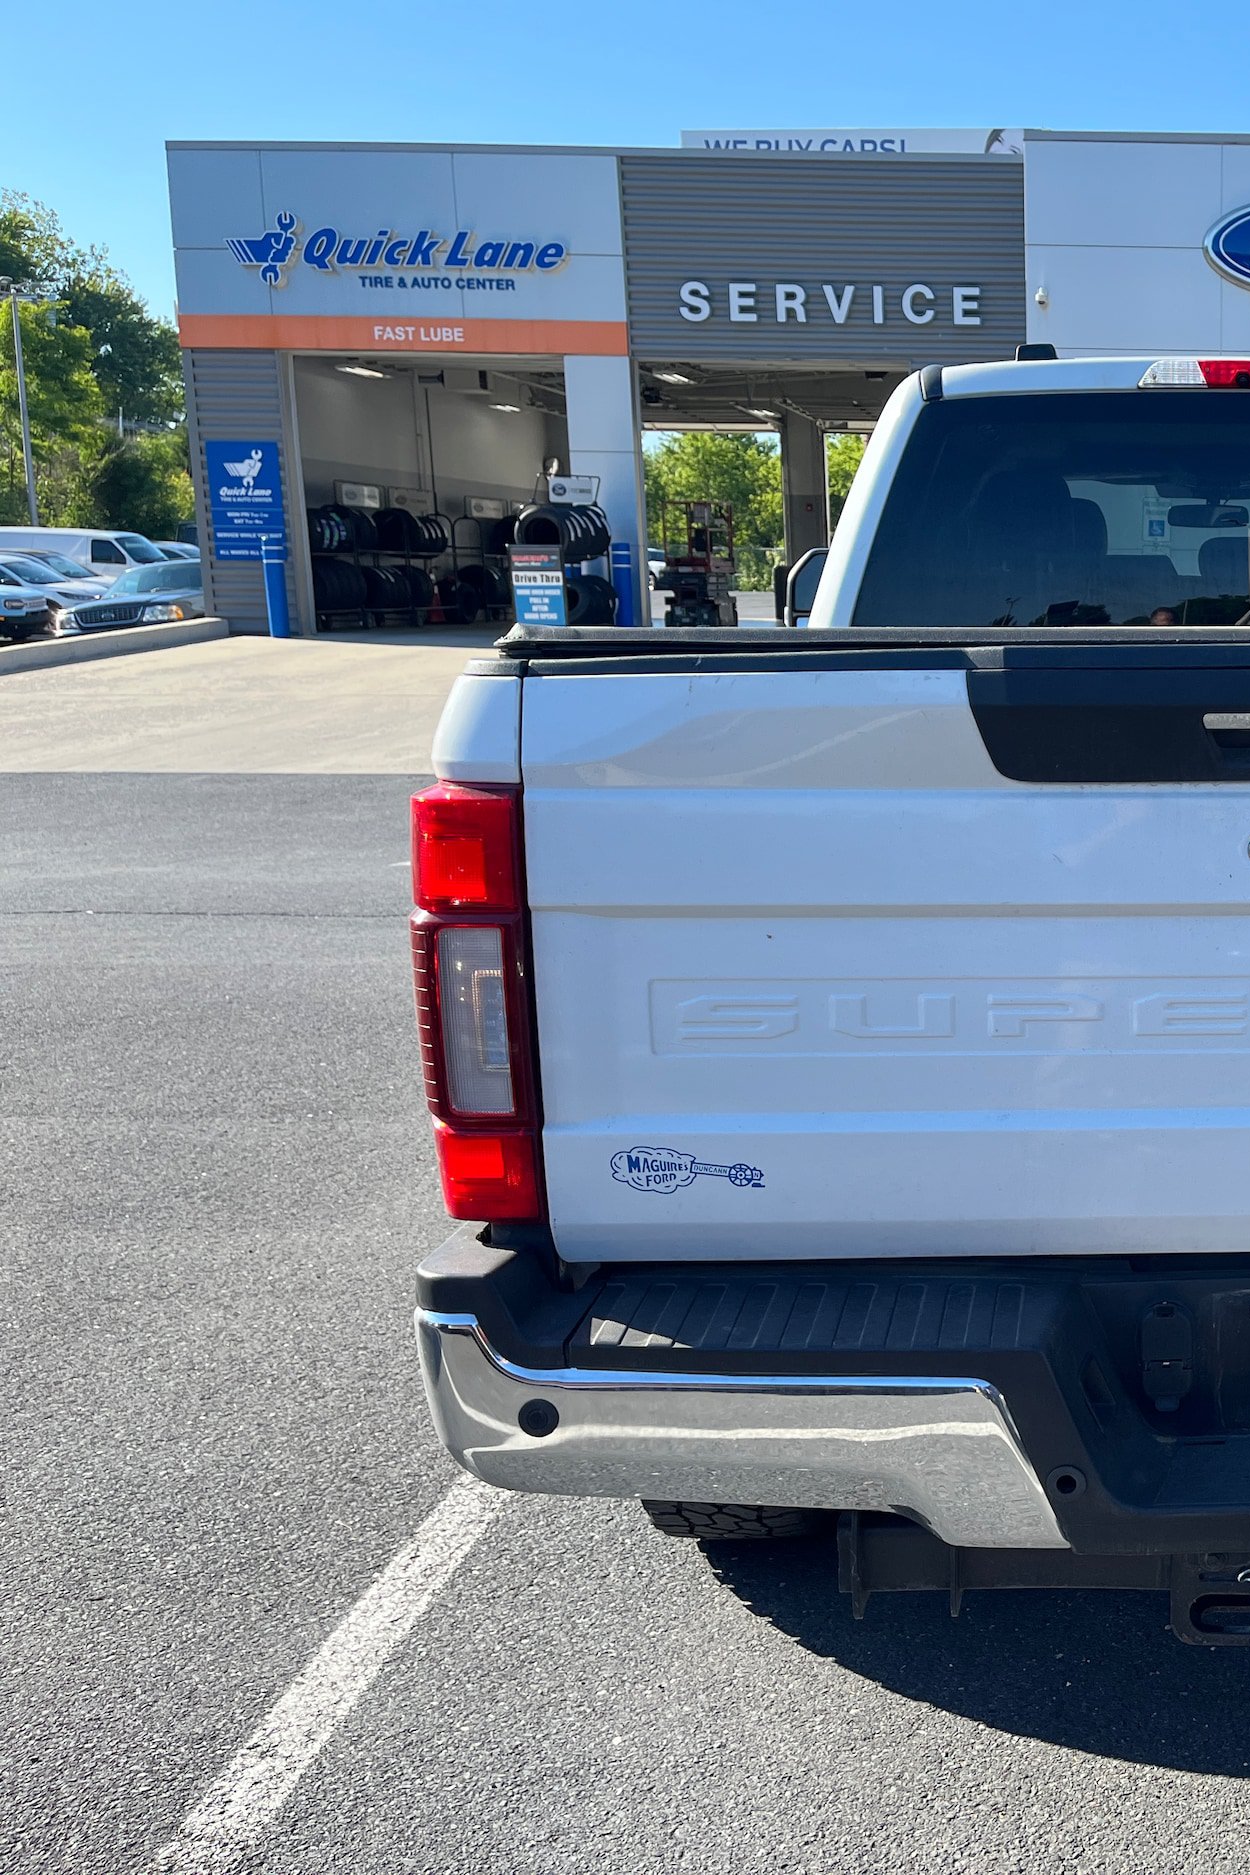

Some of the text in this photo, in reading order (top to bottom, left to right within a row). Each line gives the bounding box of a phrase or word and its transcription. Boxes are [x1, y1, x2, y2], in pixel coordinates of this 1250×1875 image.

[303, 227, 569, 271] Quick Lane
[359, 276, 516, 291] TIRE & AUTO CENTER
[679, 280, 982, 325] SERVICE
[373, 326, 465, 342] FAST LUBE
[219, 487, 247, 496] Quick
[514, 574, 560, 583] Drive Thru
[645, 1172, 677, 1187] FORD
